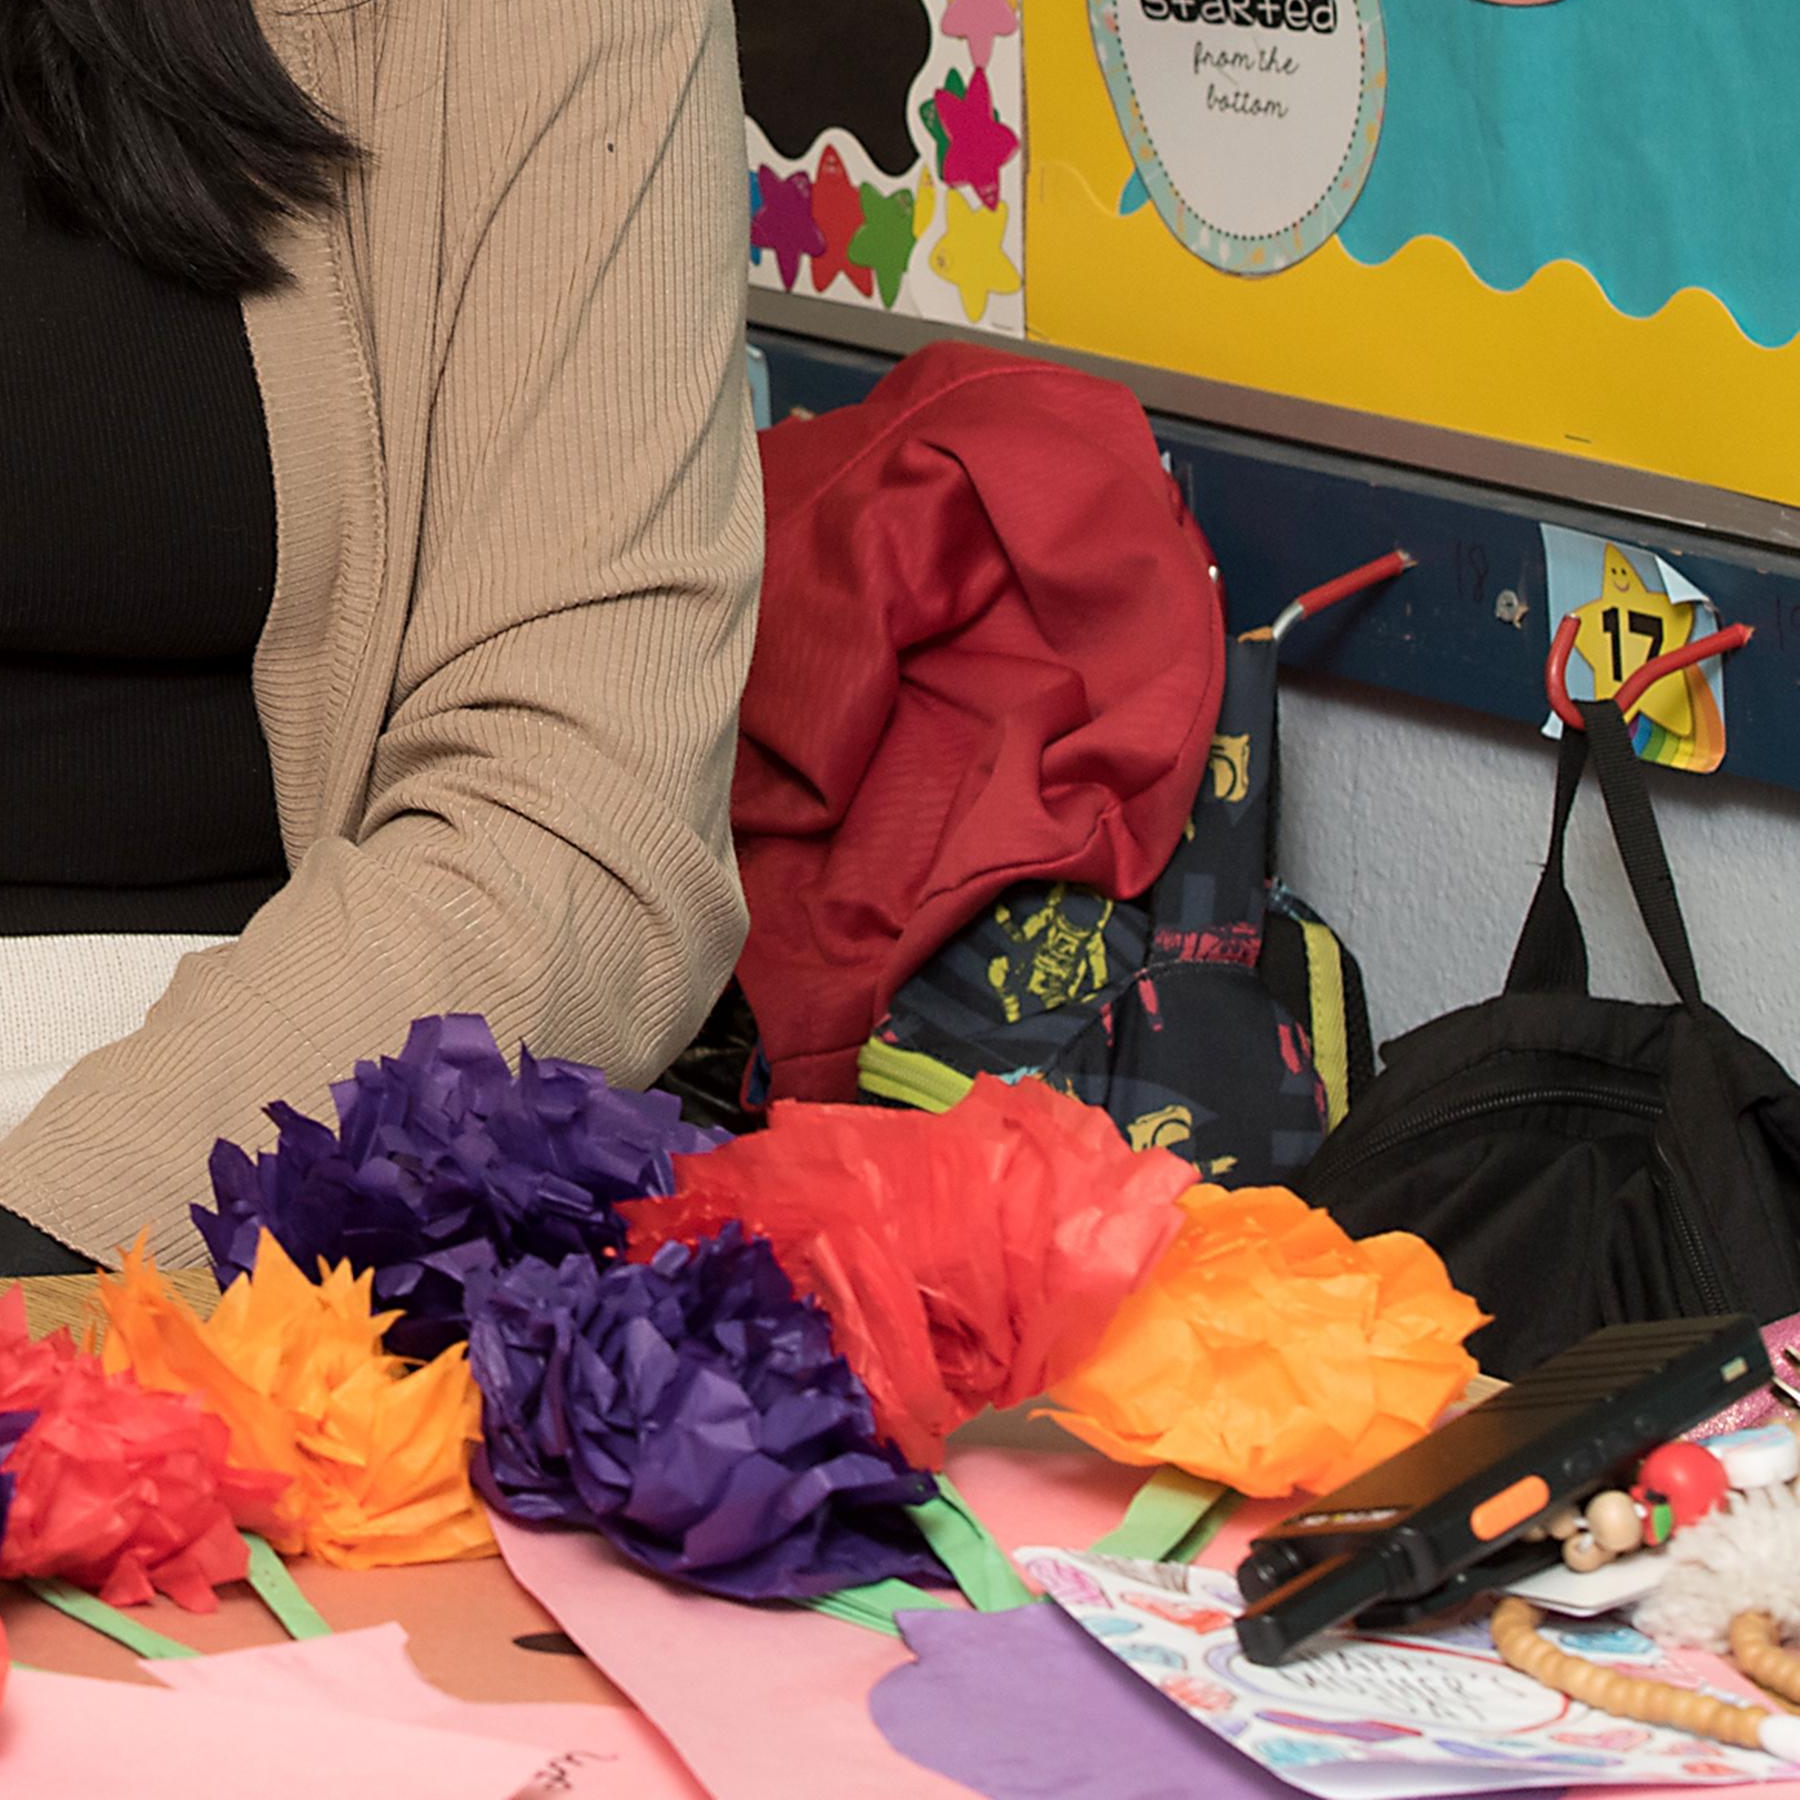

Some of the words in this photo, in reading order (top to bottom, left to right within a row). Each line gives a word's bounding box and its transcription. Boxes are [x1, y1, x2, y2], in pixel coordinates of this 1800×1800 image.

[1193, 40, 1255, 75] from
[1258, 46, 1299, 76] the
[1206, 83, 1288, 119] bottom
[1602, 606, 1663, 683] 17
